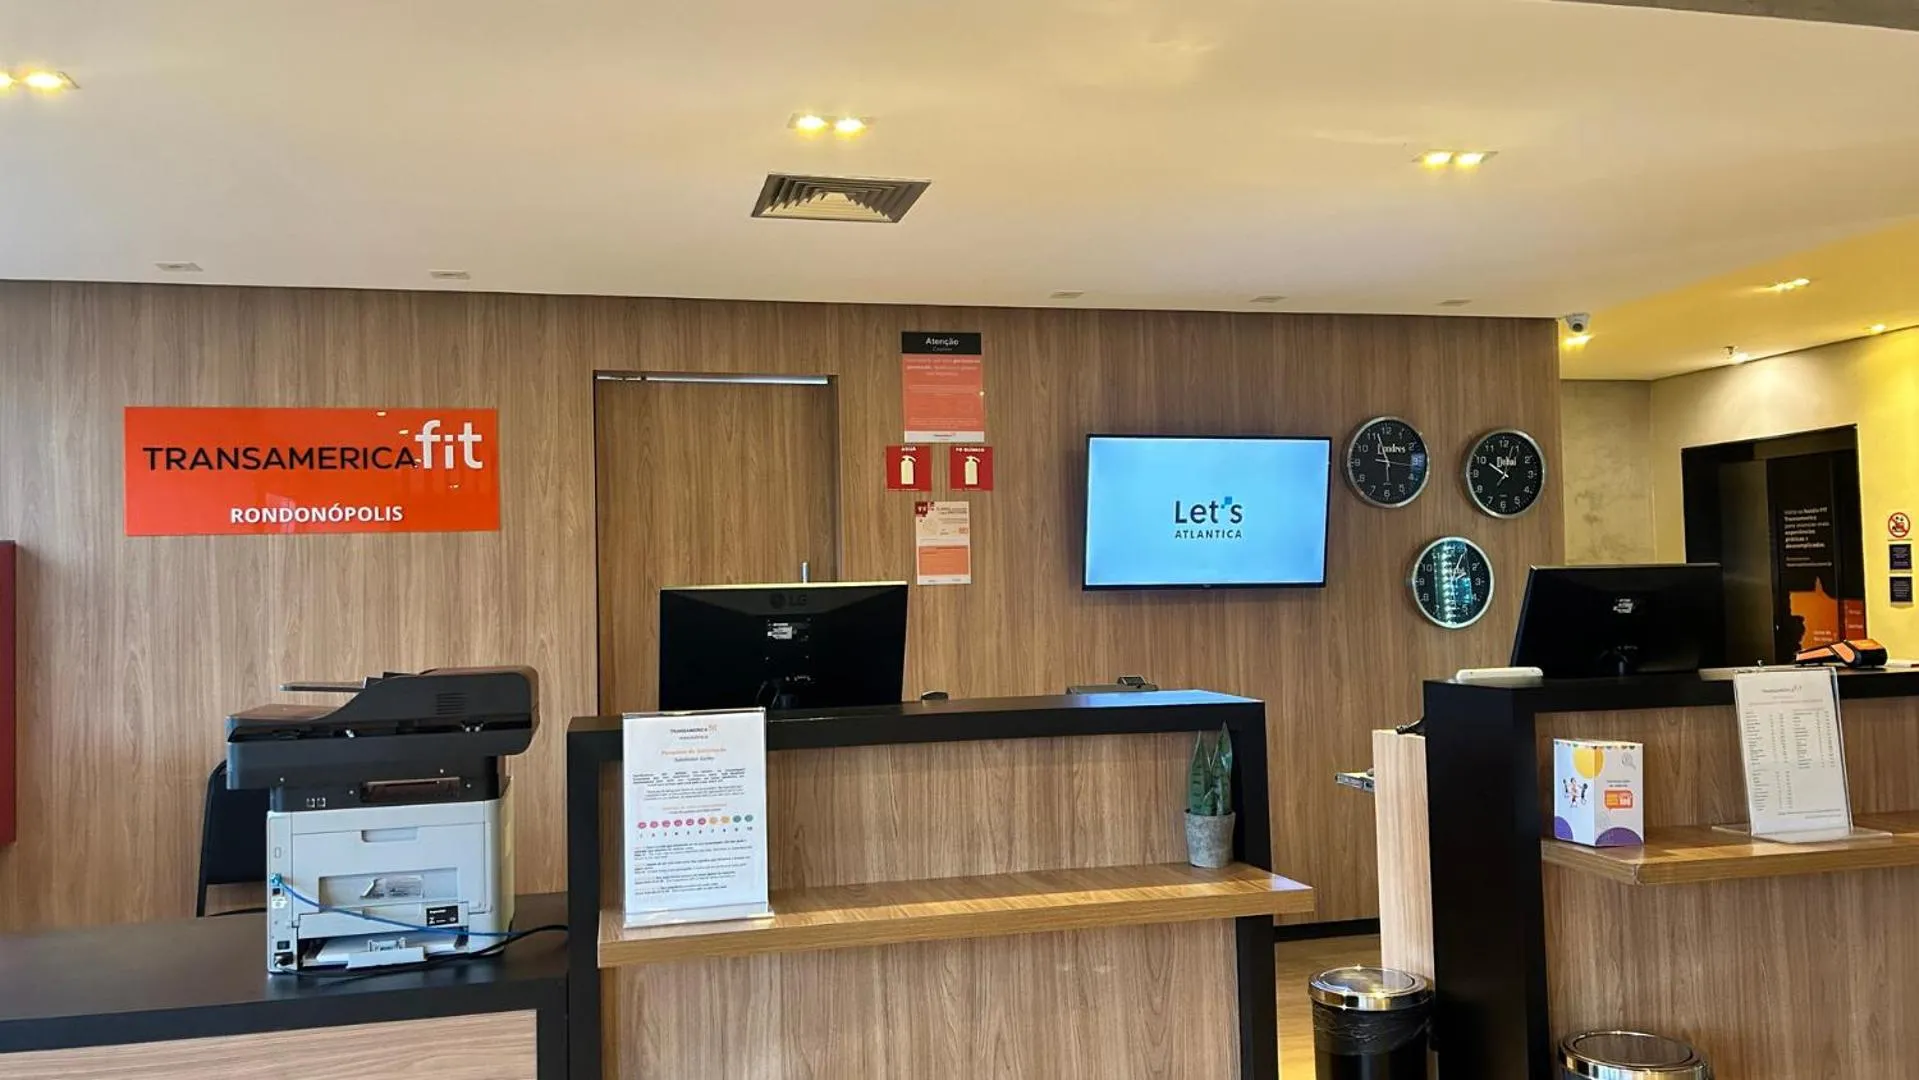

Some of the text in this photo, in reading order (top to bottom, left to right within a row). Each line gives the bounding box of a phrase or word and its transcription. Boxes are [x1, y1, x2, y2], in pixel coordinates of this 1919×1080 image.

[926, 337, 958, 346] Atenção
[142, 420, 483, 470] TRANSAMERICA fit
[230, 502, 404, 524] RONDONÓPOLIS
[1175, 497, 1243, 524] Let's
[1174, 530, 1242, 539] ATLANTICA
[789, 594, 807, 606] LG
